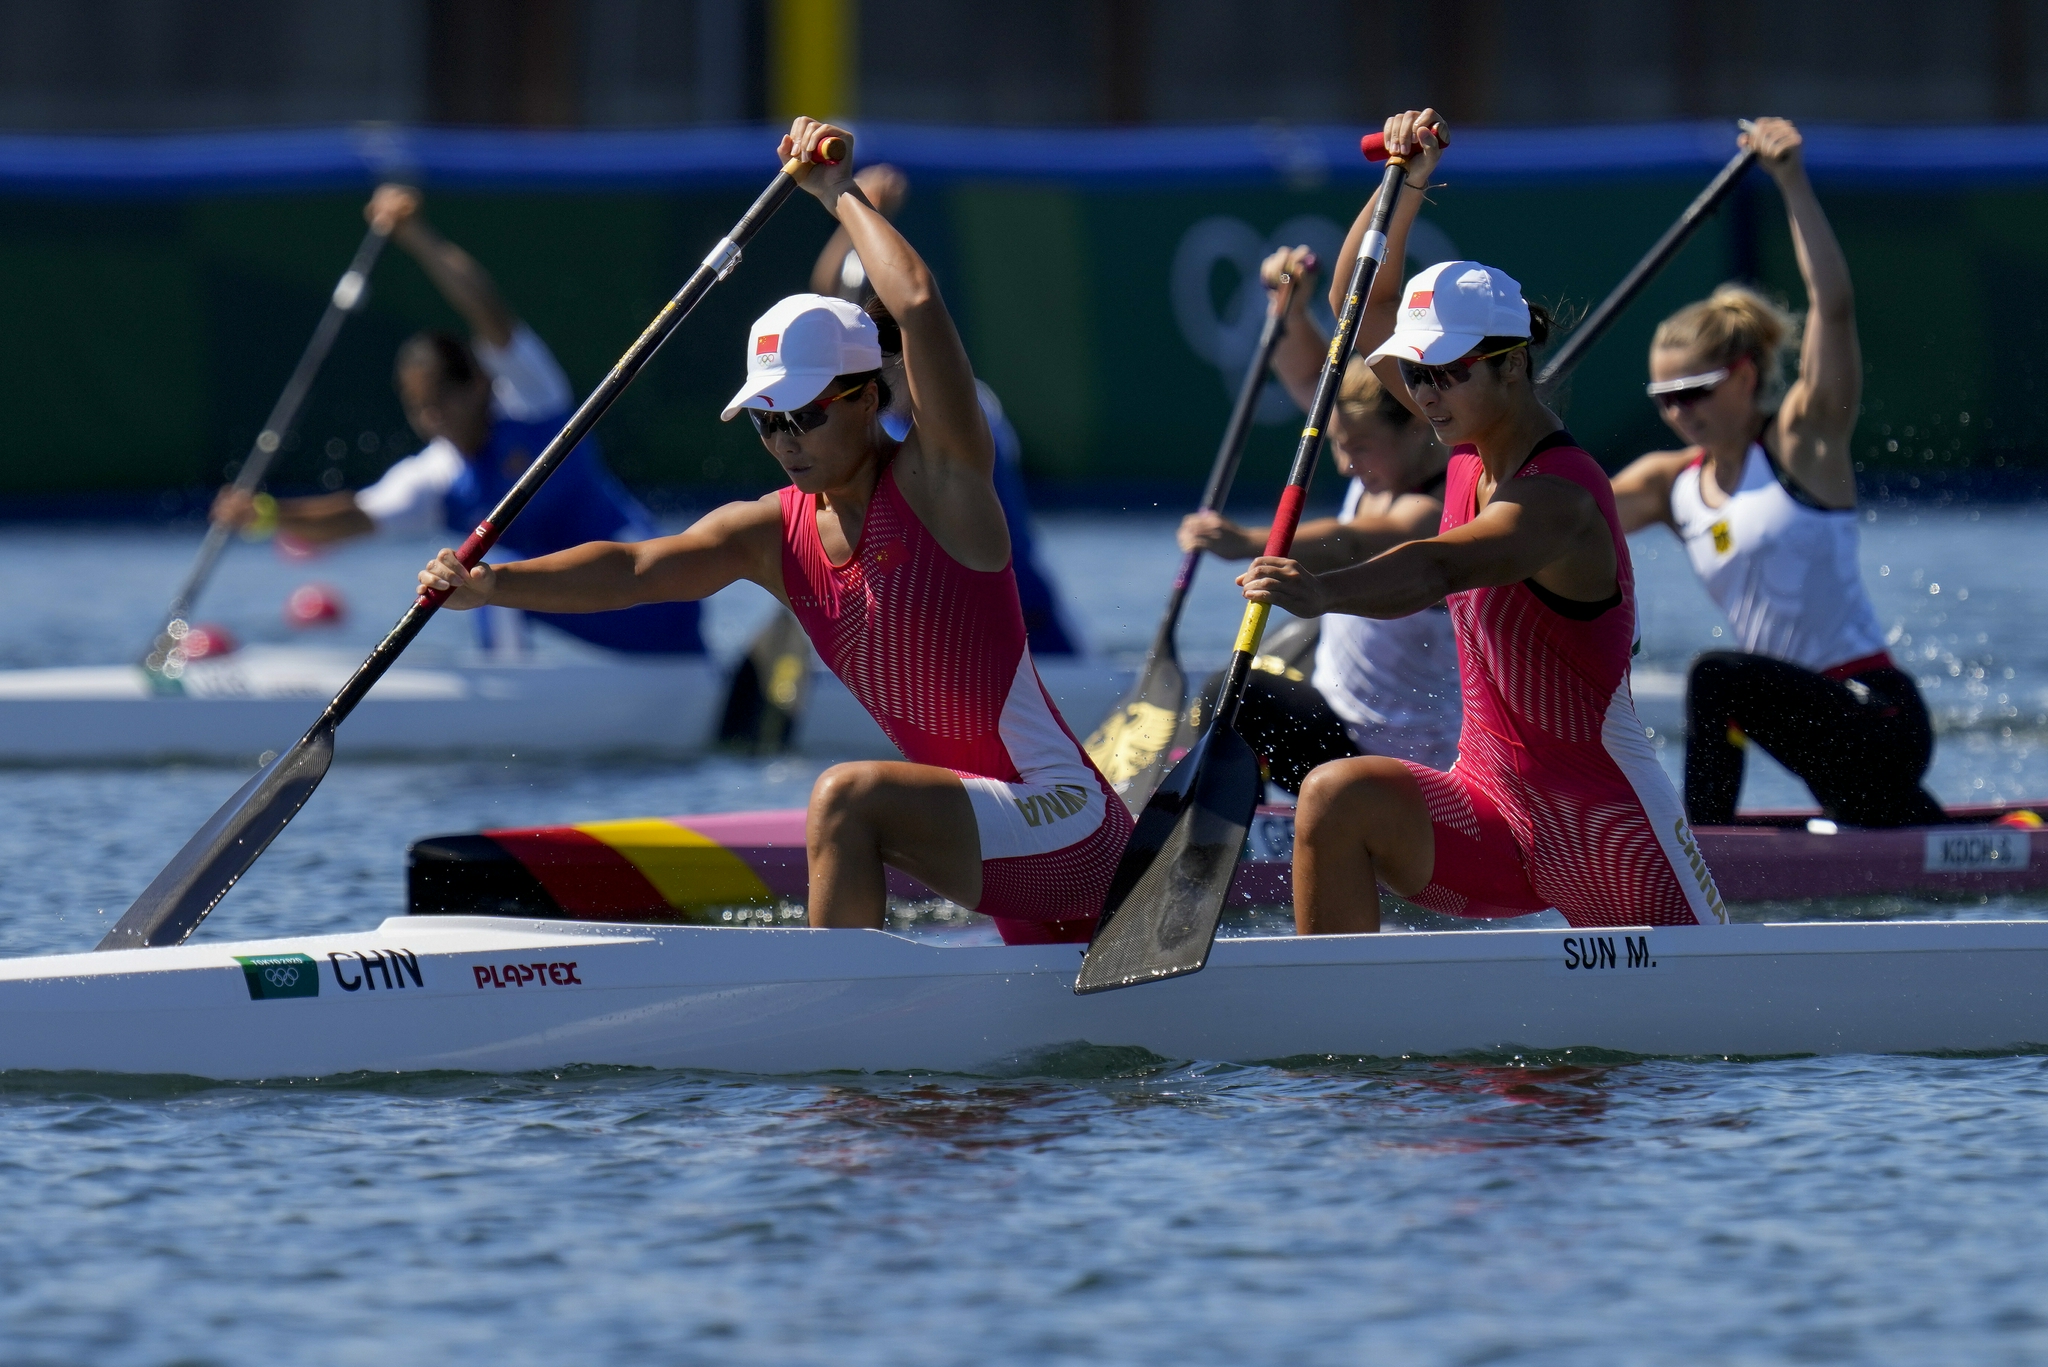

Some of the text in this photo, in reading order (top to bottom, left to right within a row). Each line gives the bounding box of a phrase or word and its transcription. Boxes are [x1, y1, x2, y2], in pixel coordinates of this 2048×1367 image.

[250, 957, 304, 967] TOKYO 2020
[1563, 936, 1657, 970] SUN M.
[327, 948, 424, 992] CHN
[472, 962, 582, 989] PLASTEX
